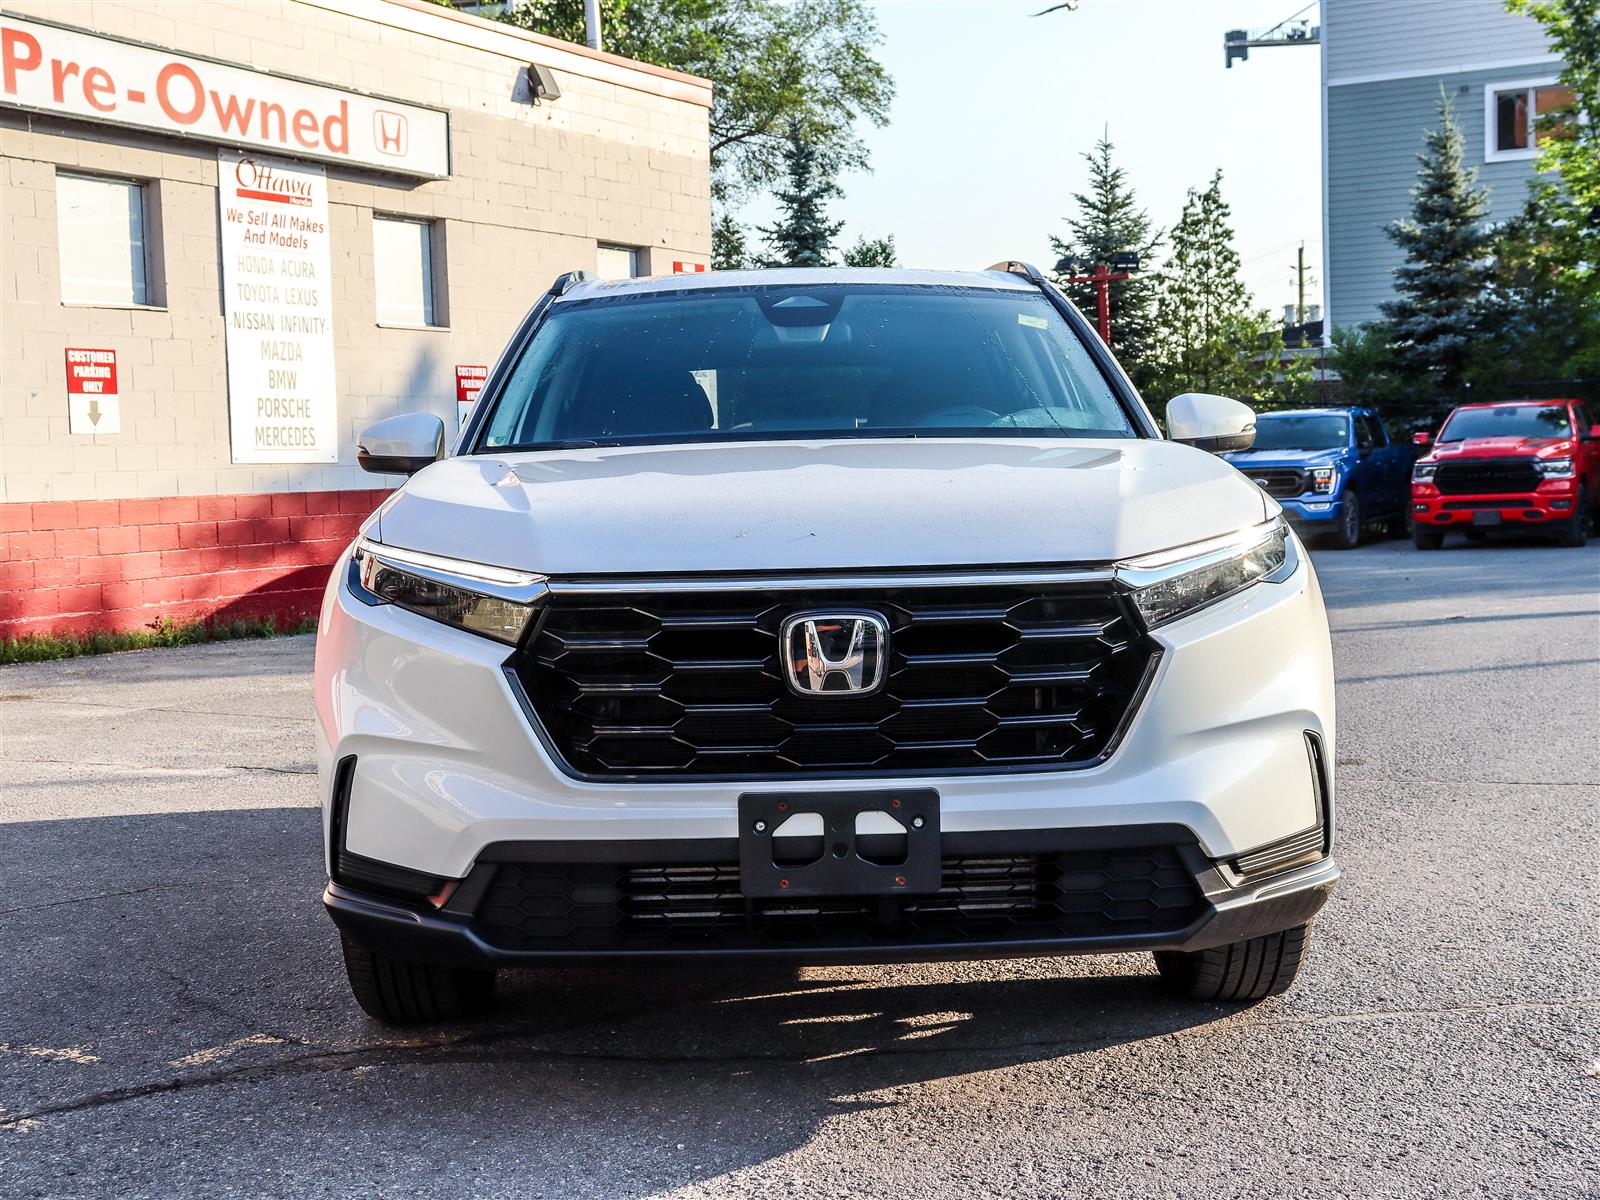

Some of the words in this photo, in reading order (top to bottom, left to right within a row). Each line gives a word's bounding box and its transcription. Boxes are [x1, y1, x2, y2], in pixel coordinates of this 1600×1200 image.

[1, 26, 350, 155] Pre-Owned
[235, 158, 312, 196] Ottawa
[226, 207, 243, 223] We
[247, 210, 268, 226] Sell
[271, 213, 287, 229] All
[289, 216, 324, 233] Makes
[244, 228, 266, 245] And
[269, 231, 308, 249] Models
[237, 255, 275, 275] HONDA
[281, 259, 316, 279] ACURA
[237, 283, 279, 304] TOYOTA
[285, 287, 318, 306] LEXUS
[233, 311, 275, 331] NISSAN
[281, 314, 326, 335] INFINITY
[68, 350, 115, 363] CUSTOMER
[261, 340, 303, 361] MAZDA
[73, 365, 111, 378] PARKING
[268, 369, 297, 390] BMW
[82, 381, 103, 392] ONLY
[257, 397, 311, 418] PORSCHE
[255, 426, 316, 447] MERCEDES
